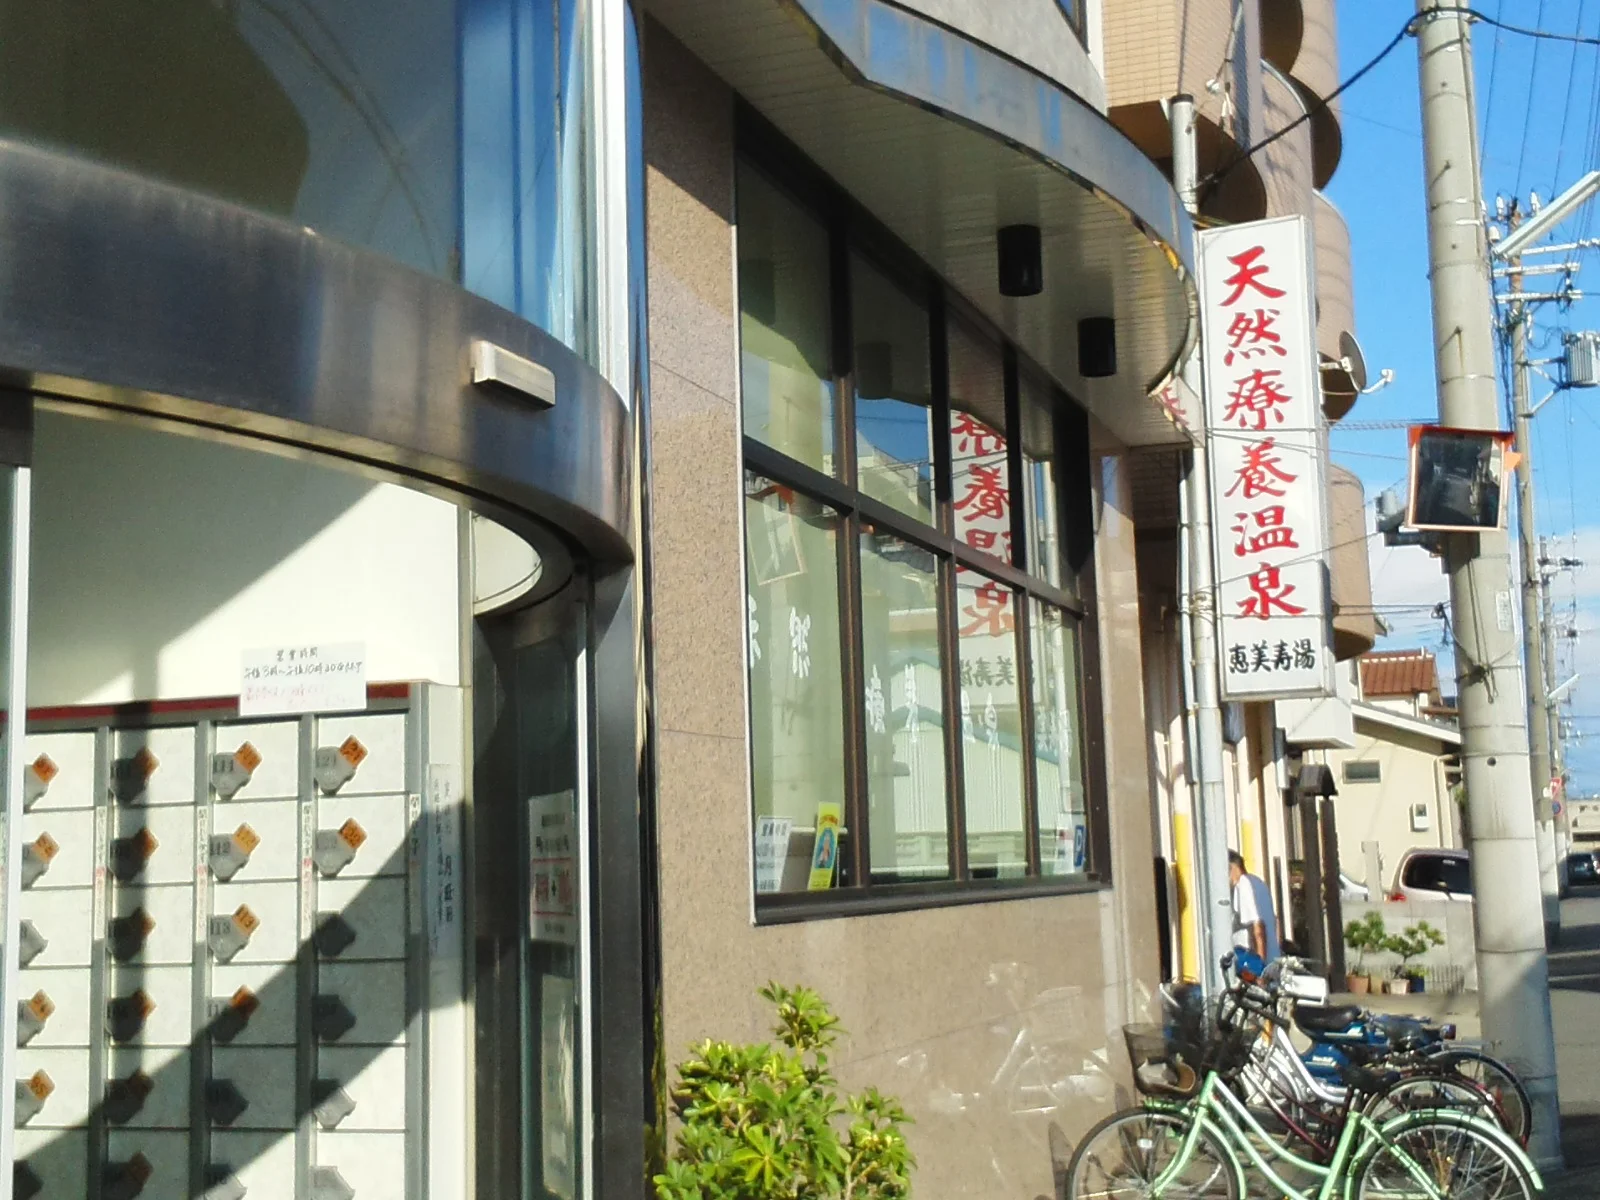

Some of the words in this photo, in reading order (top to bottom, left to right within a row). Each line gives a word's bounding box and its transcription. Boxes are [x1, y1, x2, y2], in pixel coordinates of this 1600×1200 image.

[1220, 245, 1308, 620] 天然療養温泉
[1228, 638, 1316, 675] 恵美寿湯
